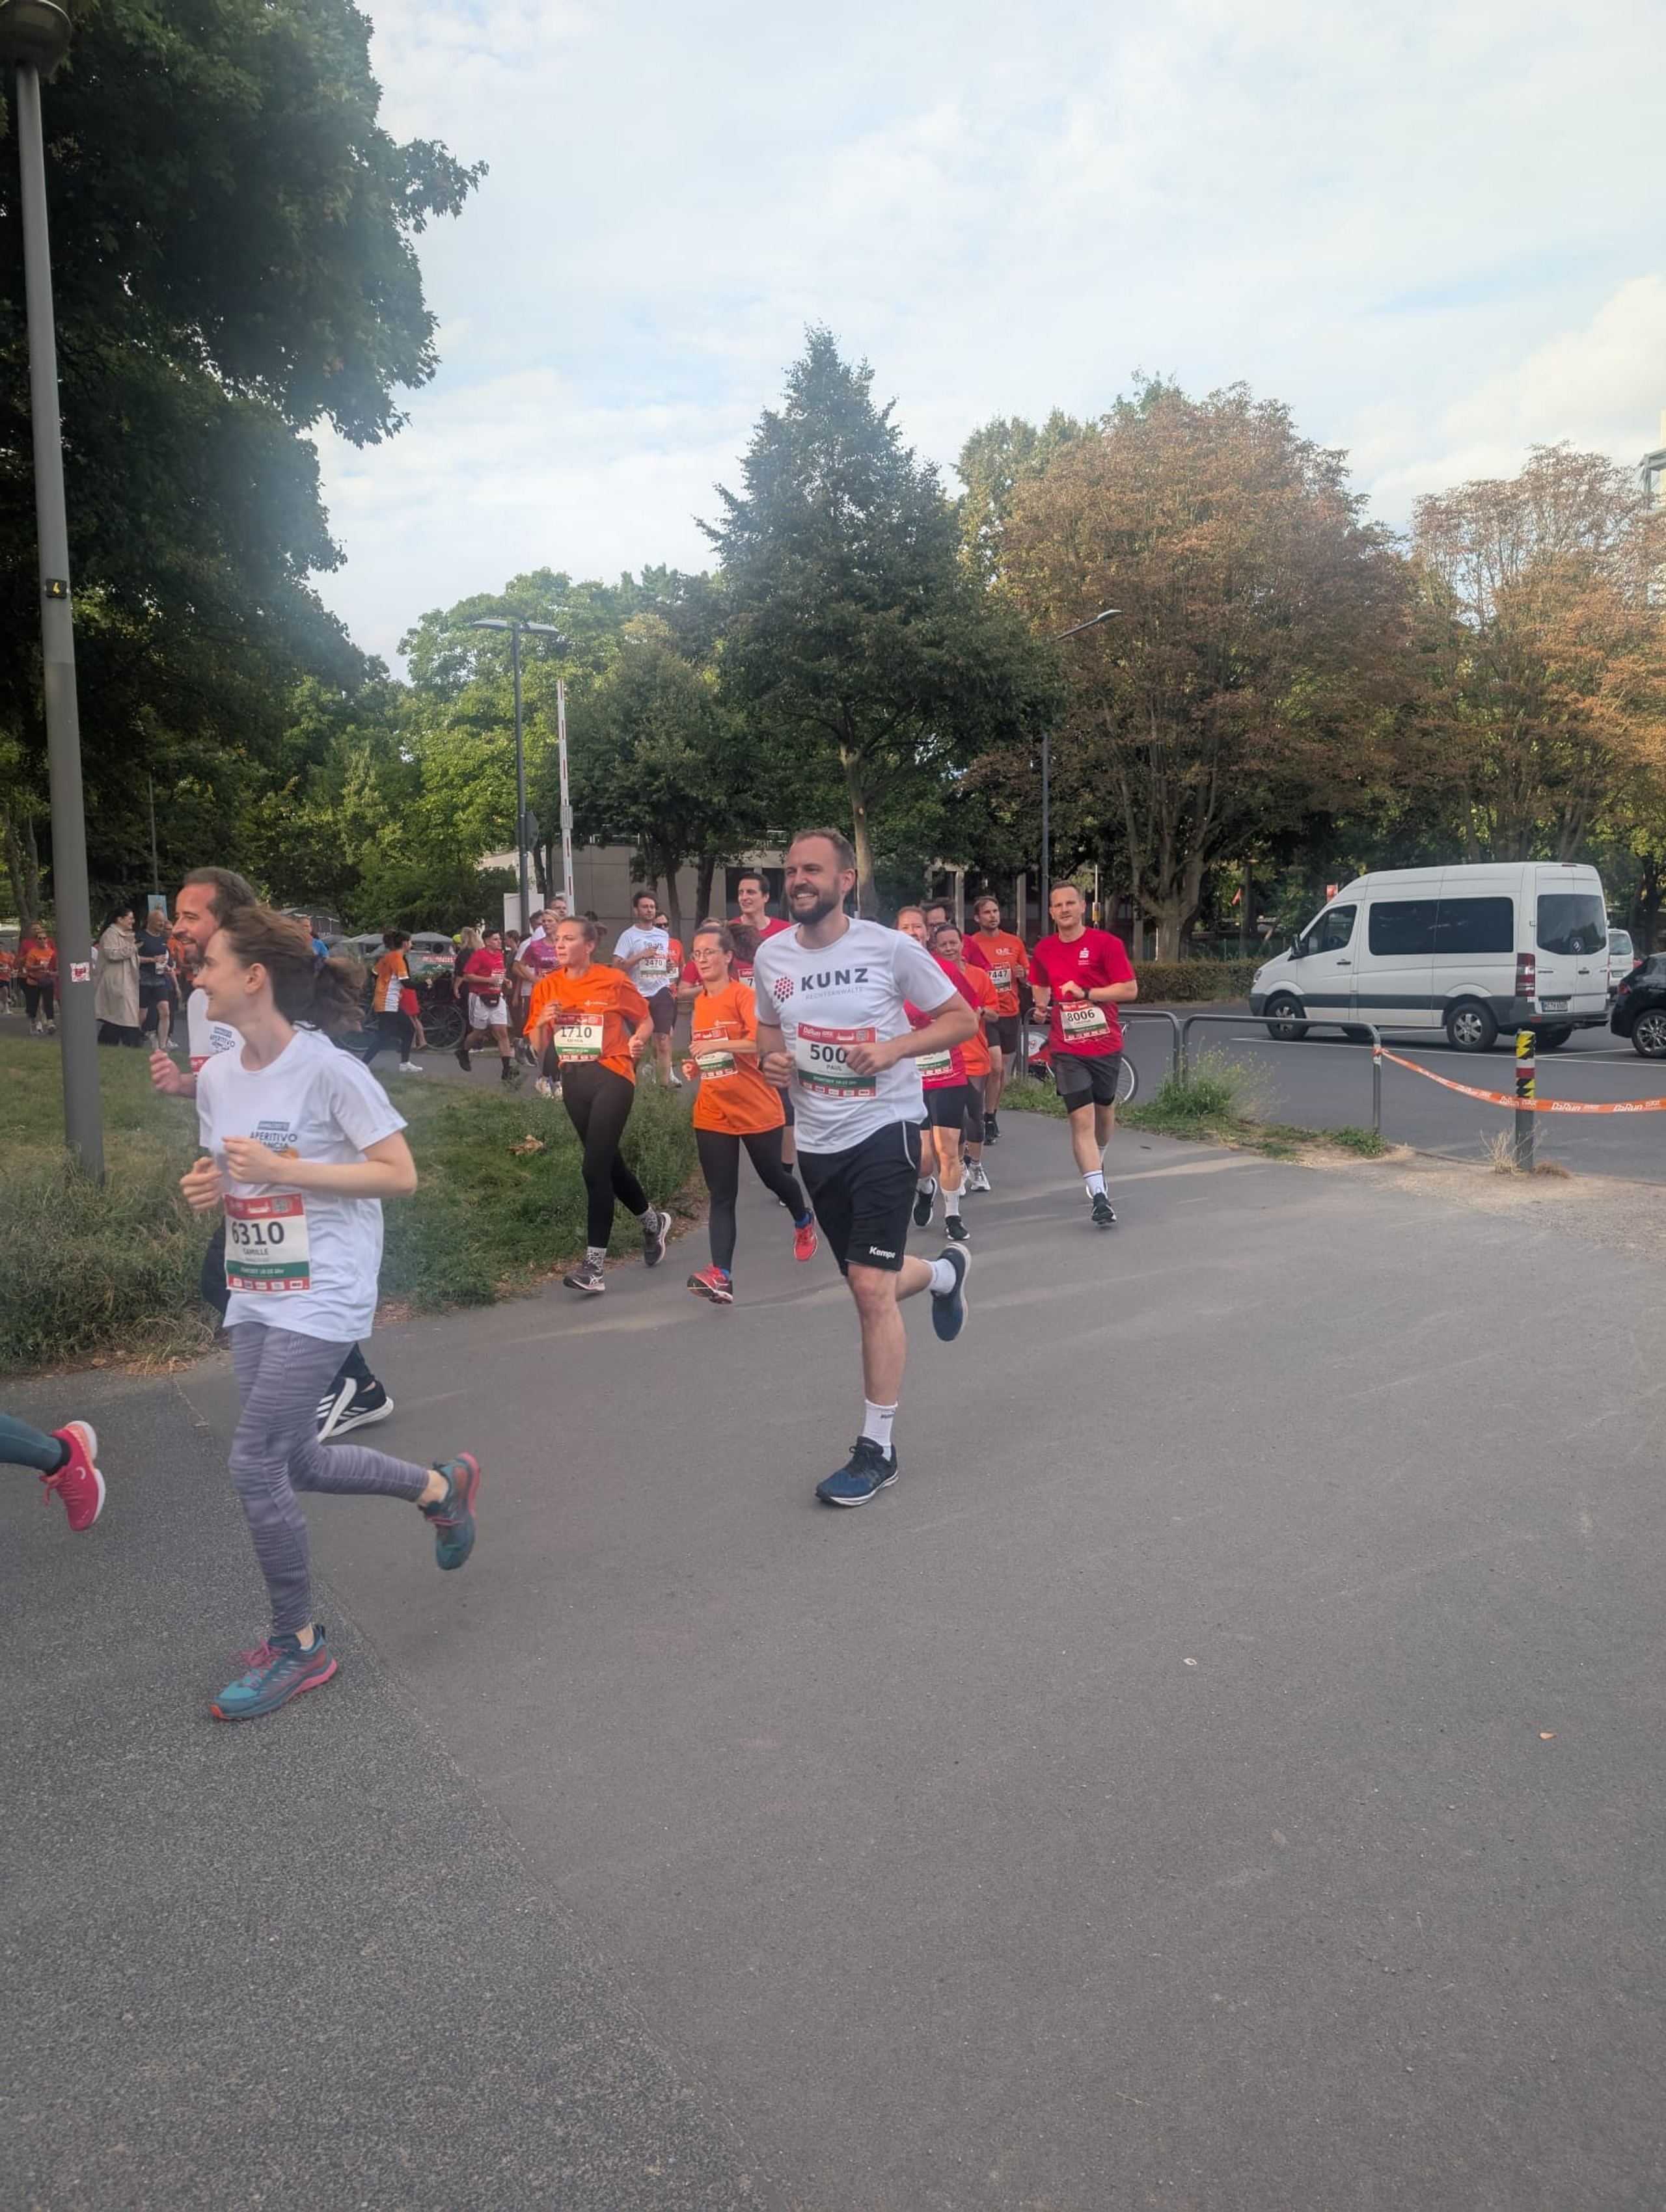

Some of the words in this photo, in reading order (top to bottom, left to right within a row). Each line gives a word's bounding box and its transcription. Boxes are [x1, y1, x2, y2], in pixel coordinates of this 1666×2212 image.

[801, 967, 869, 991] KUNZ
[1067, 1009, 1095, 1022] 8006
[561, 1027, 592, 1038] 1710
[810, 1044, 848, 1064] 500
[1551, 1101, 1581, 1111] DaRun
[1613, 1103, 1643, 1112] DaRun
[249, 1131, 297, 1143] APERITIVO
[232, 1221, 284, 1245] 6310
